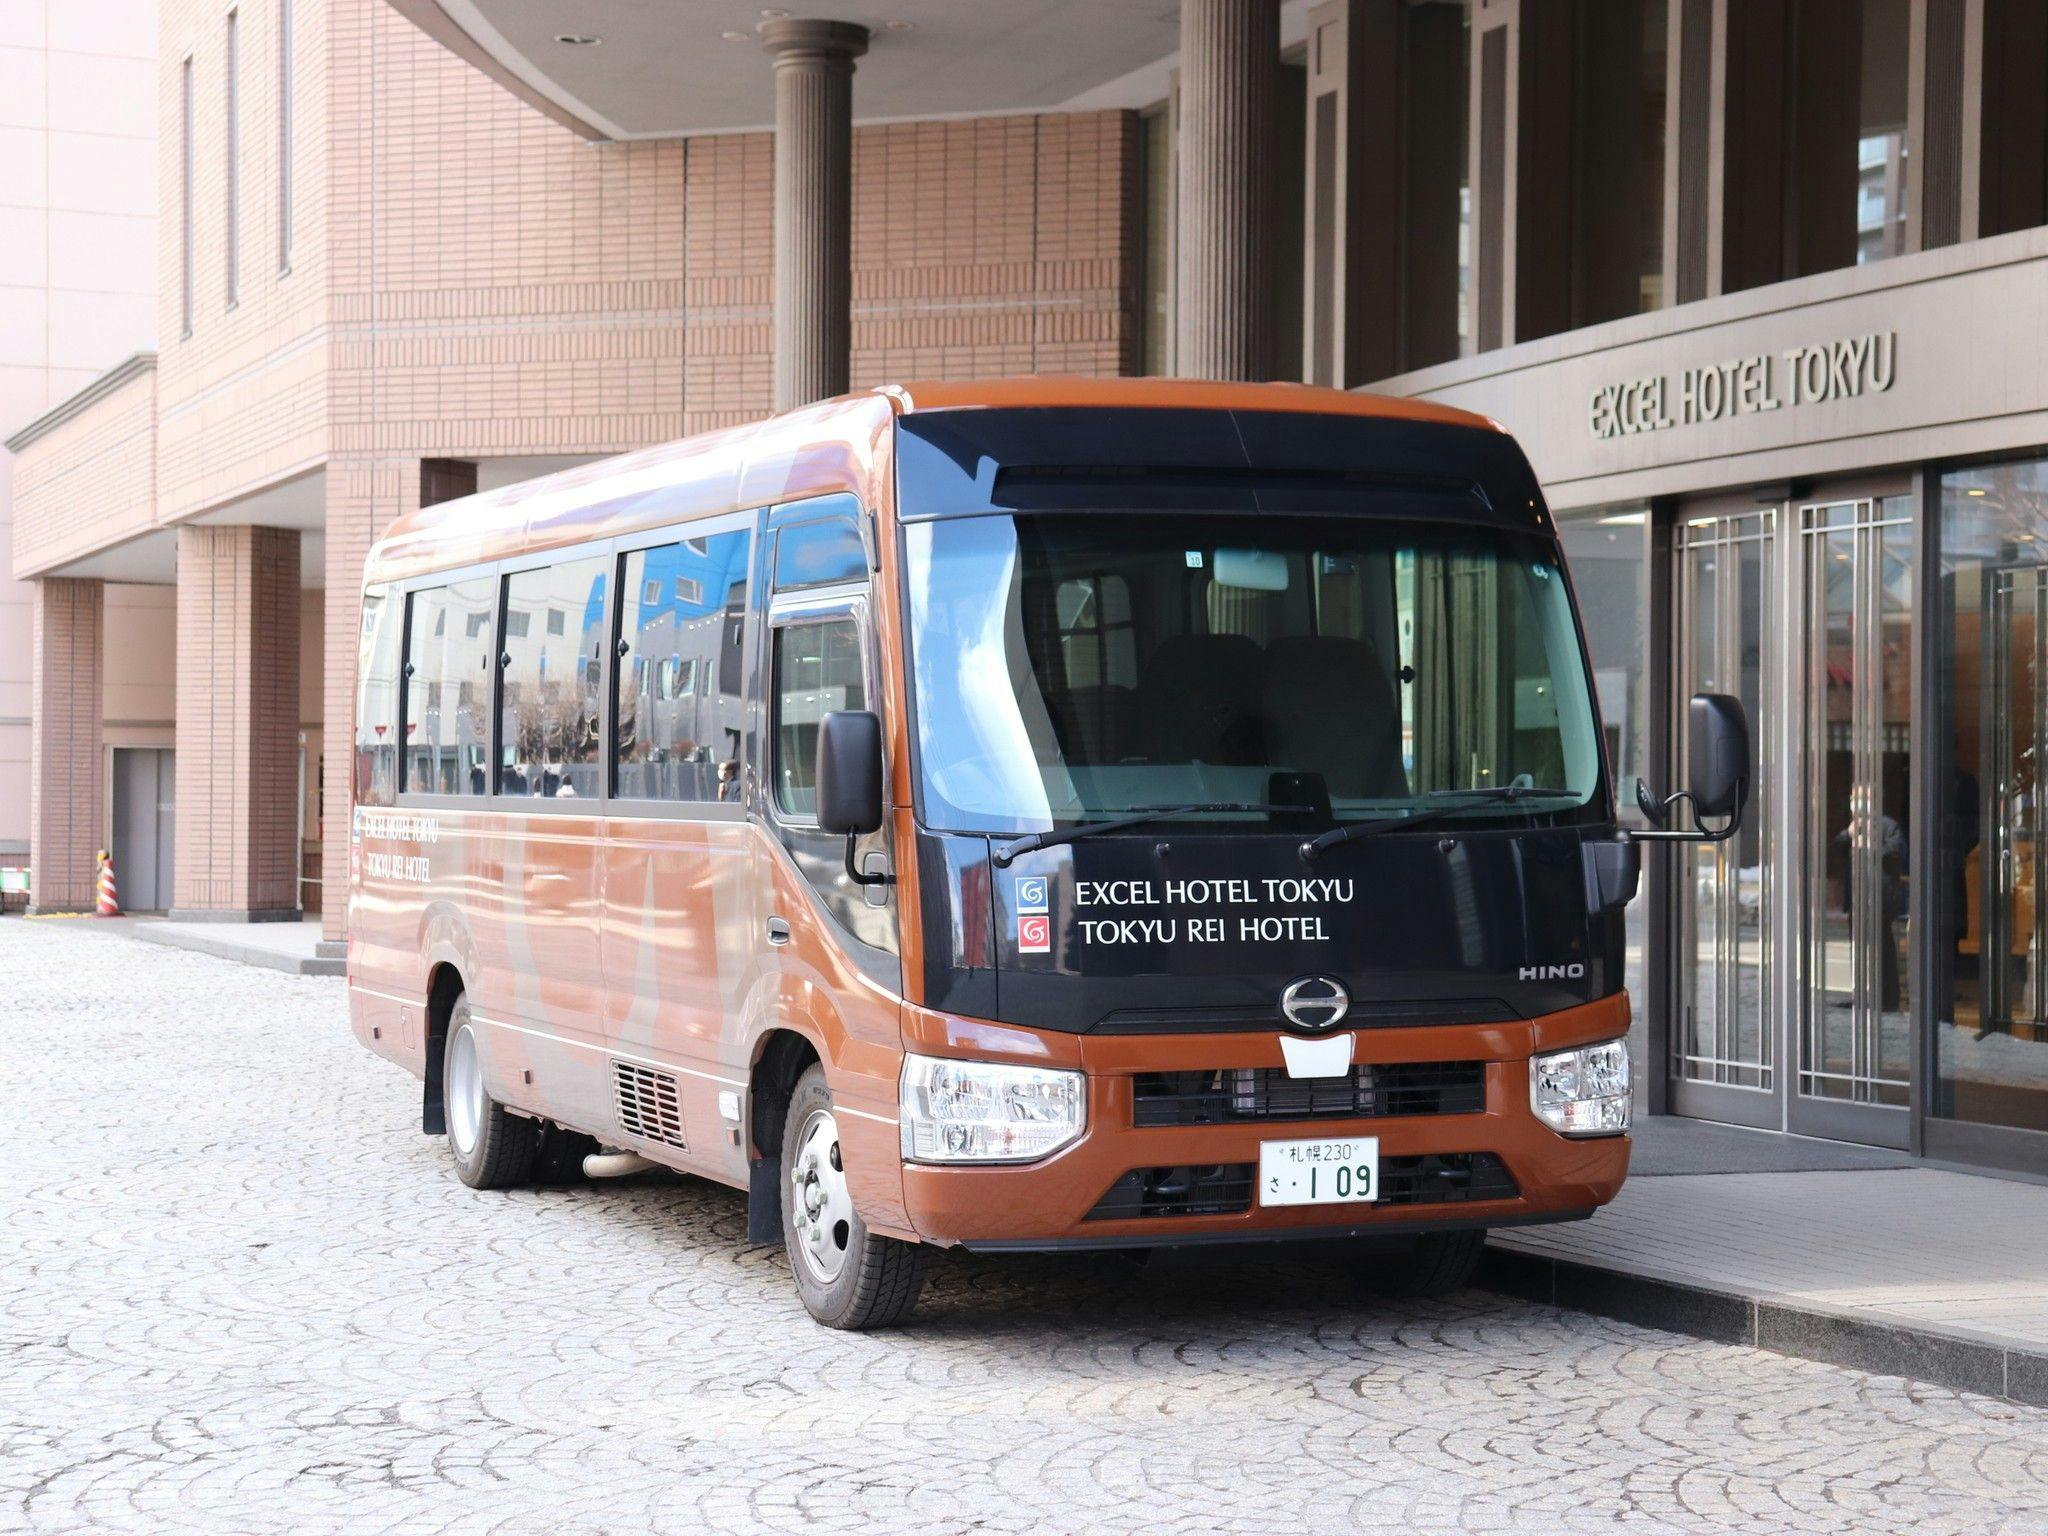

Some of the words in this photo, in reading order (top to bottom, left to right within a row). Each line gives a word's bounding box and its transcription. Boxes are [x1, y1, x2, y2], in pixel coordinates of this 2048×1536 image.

[1588, 376, 1674, 439] EXCEL
[1679, 355, 1781, 424] HOTEL
[1783, 331, 1896, 406] TOKYU
[406, 856, 432, 883] HOTEL
[1075, 880, 1160, 906] EXCEL
[1165, 879, 1258, 904] HOTEL
[1261, 878, 1354, 903] TOKYU
[1078, 919, 1176, 945] TOKYU
[1188, 918, 1225, 943] REI
[1240, 917, 1330, 941] HOTEL
[1519, 963, 1584, 980] HINO
[1270, 1177, 1279, 1193] さ
